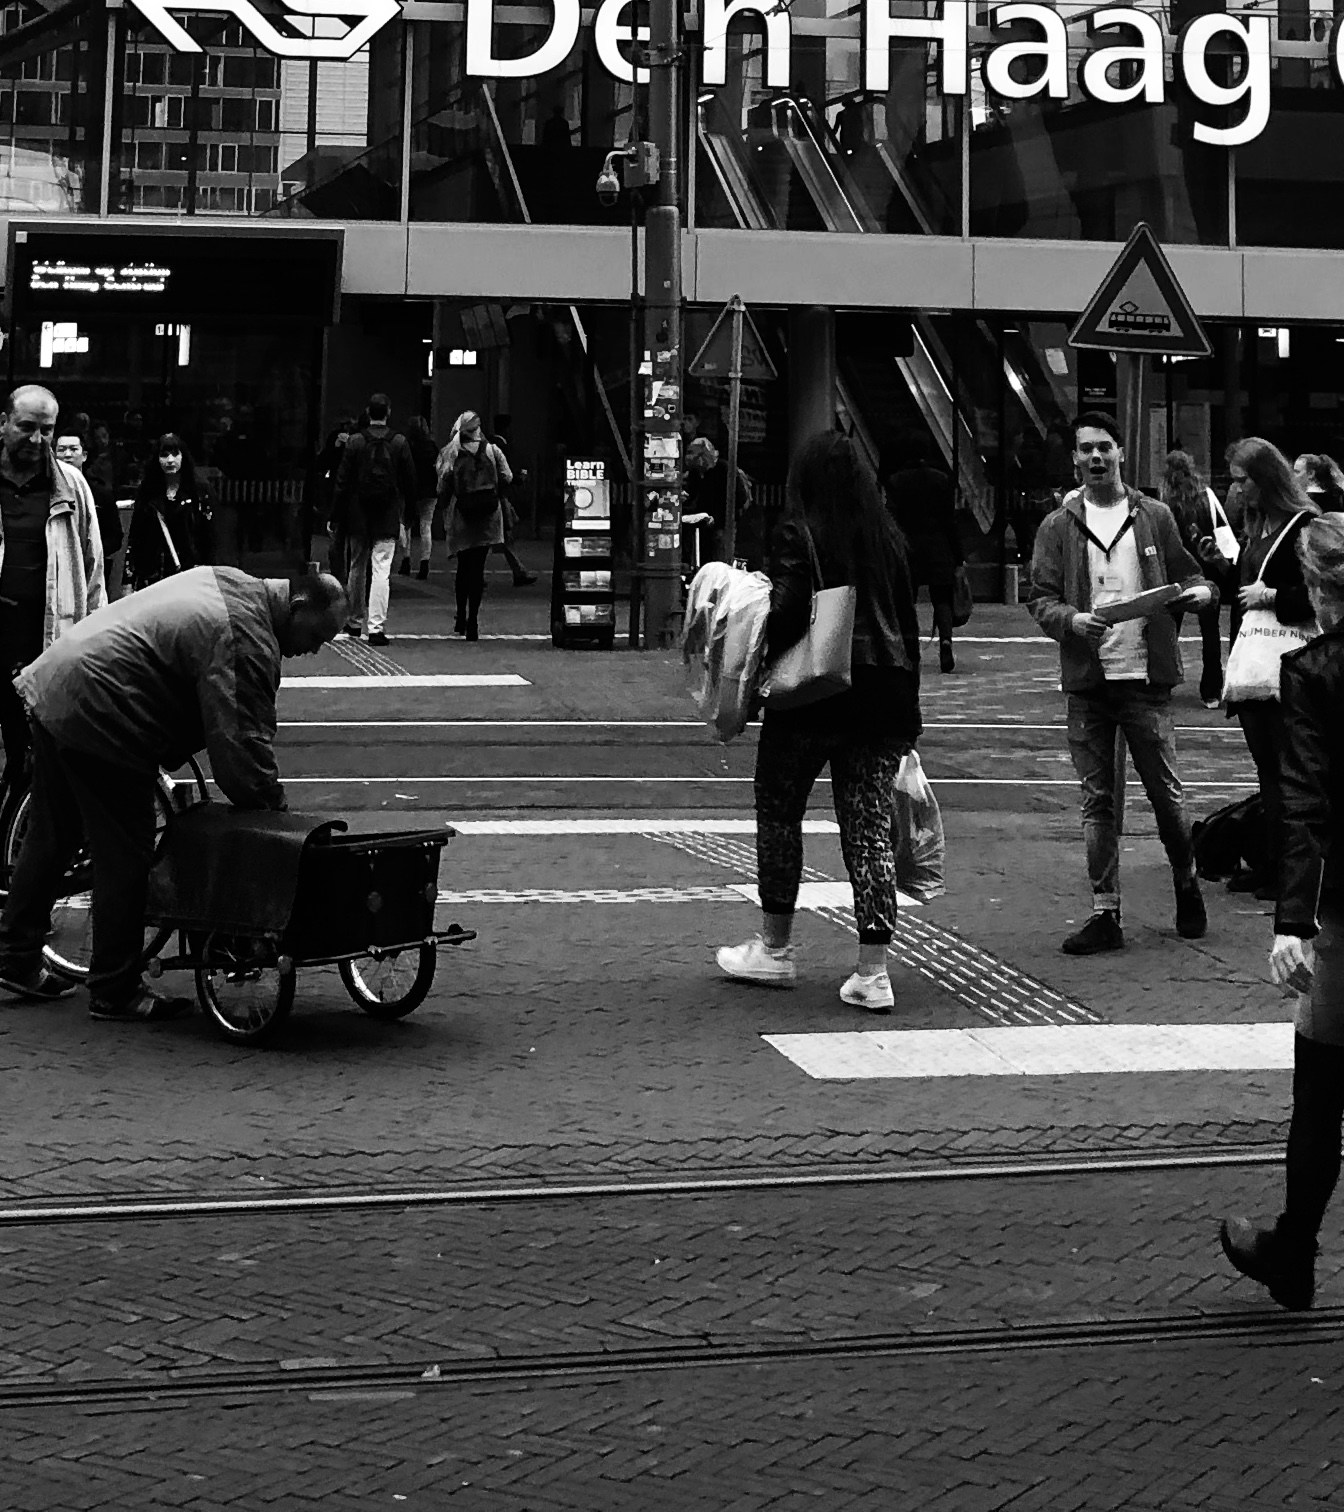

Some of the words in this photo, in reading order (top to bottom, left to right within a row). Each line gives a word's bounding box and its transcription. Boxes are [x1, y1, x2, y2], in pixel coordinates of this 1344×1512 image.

[566, 459, 605, 470] Learn
[566, 470, 605, 479] BIBLE
[1239, 627, 1287, 639] NUMBER
[1290, 629, 1311, 642] NIN
